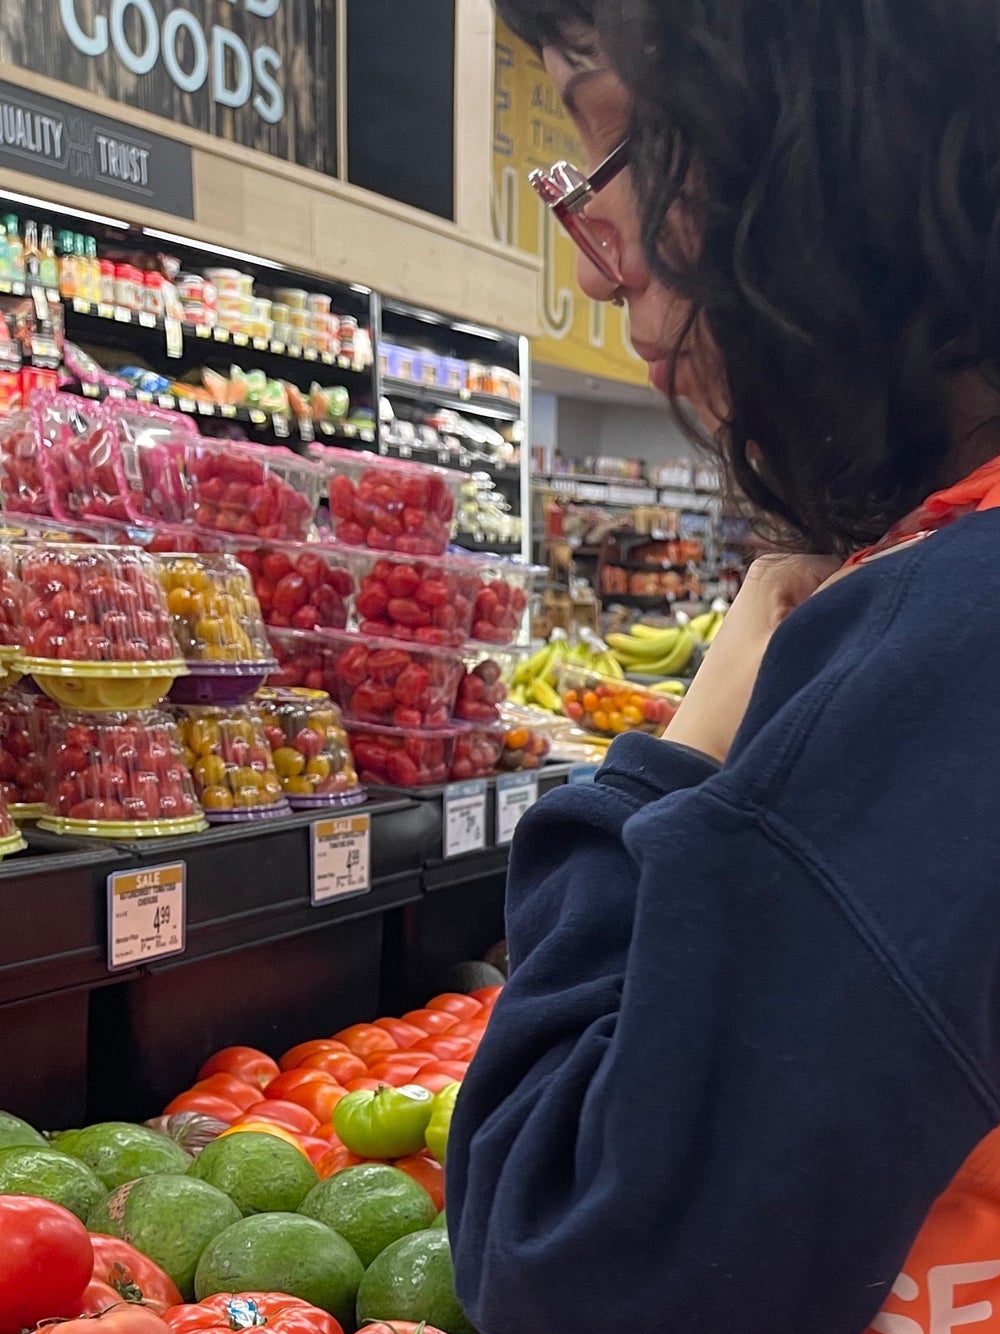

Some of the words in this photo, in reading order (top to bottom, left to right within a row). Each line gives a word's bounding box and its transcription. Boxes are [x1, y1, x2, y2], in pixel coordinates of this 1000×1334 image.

[60, 0, 285, 124] GOODS
[97, 135, 149, 186] TRUST
[136, 871, 160, 888] SALE
